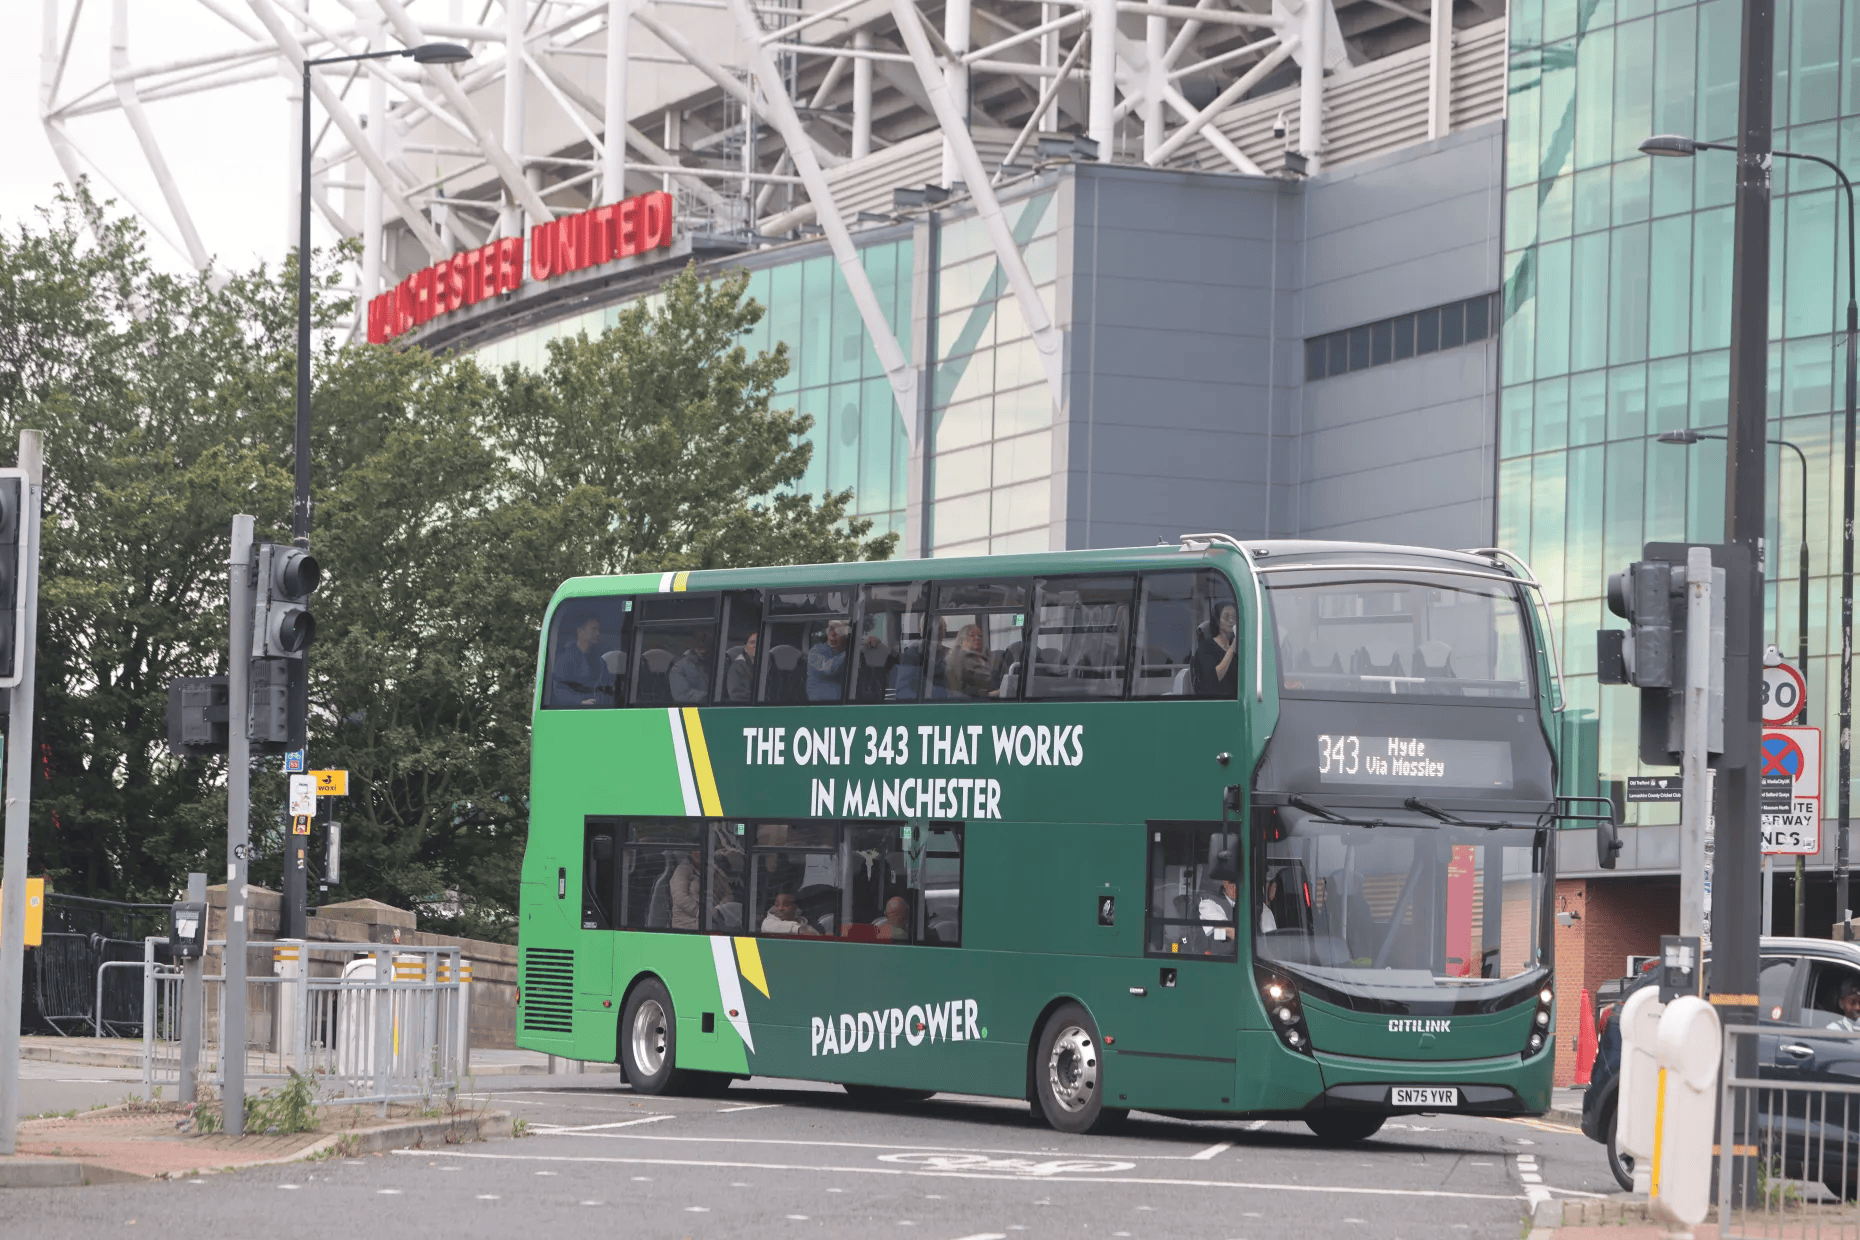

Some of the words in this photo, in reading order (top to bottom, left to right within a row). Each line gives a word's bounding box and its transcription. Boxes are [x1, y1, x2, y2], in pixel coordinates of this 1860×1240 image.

[531, 190, 673, 281] UNITED
[743, 727, 785, 765] THE
[793, 726, 857, 765] ONLY
[864, 725, 909, 766] 343
[917, 725, 983, 765] THAT
[991, 724, 1084, 767] WORKS
[1318, 735, 1360, 774] 343
[1388, 737, 1425, 757] Hyde
[1366, 756, 1388, 775] Via
[1392, 757, 1445, 777] Mossley
[810, 778, 835, 817] IN
[842, 777, 1002, 819] MANCHESTER
[1388, 1019, 1451, 1032] CITILINK
[1397, 1089, 1428, 1103] SN75
[1431, 1089, 1453, 1103] YVR
